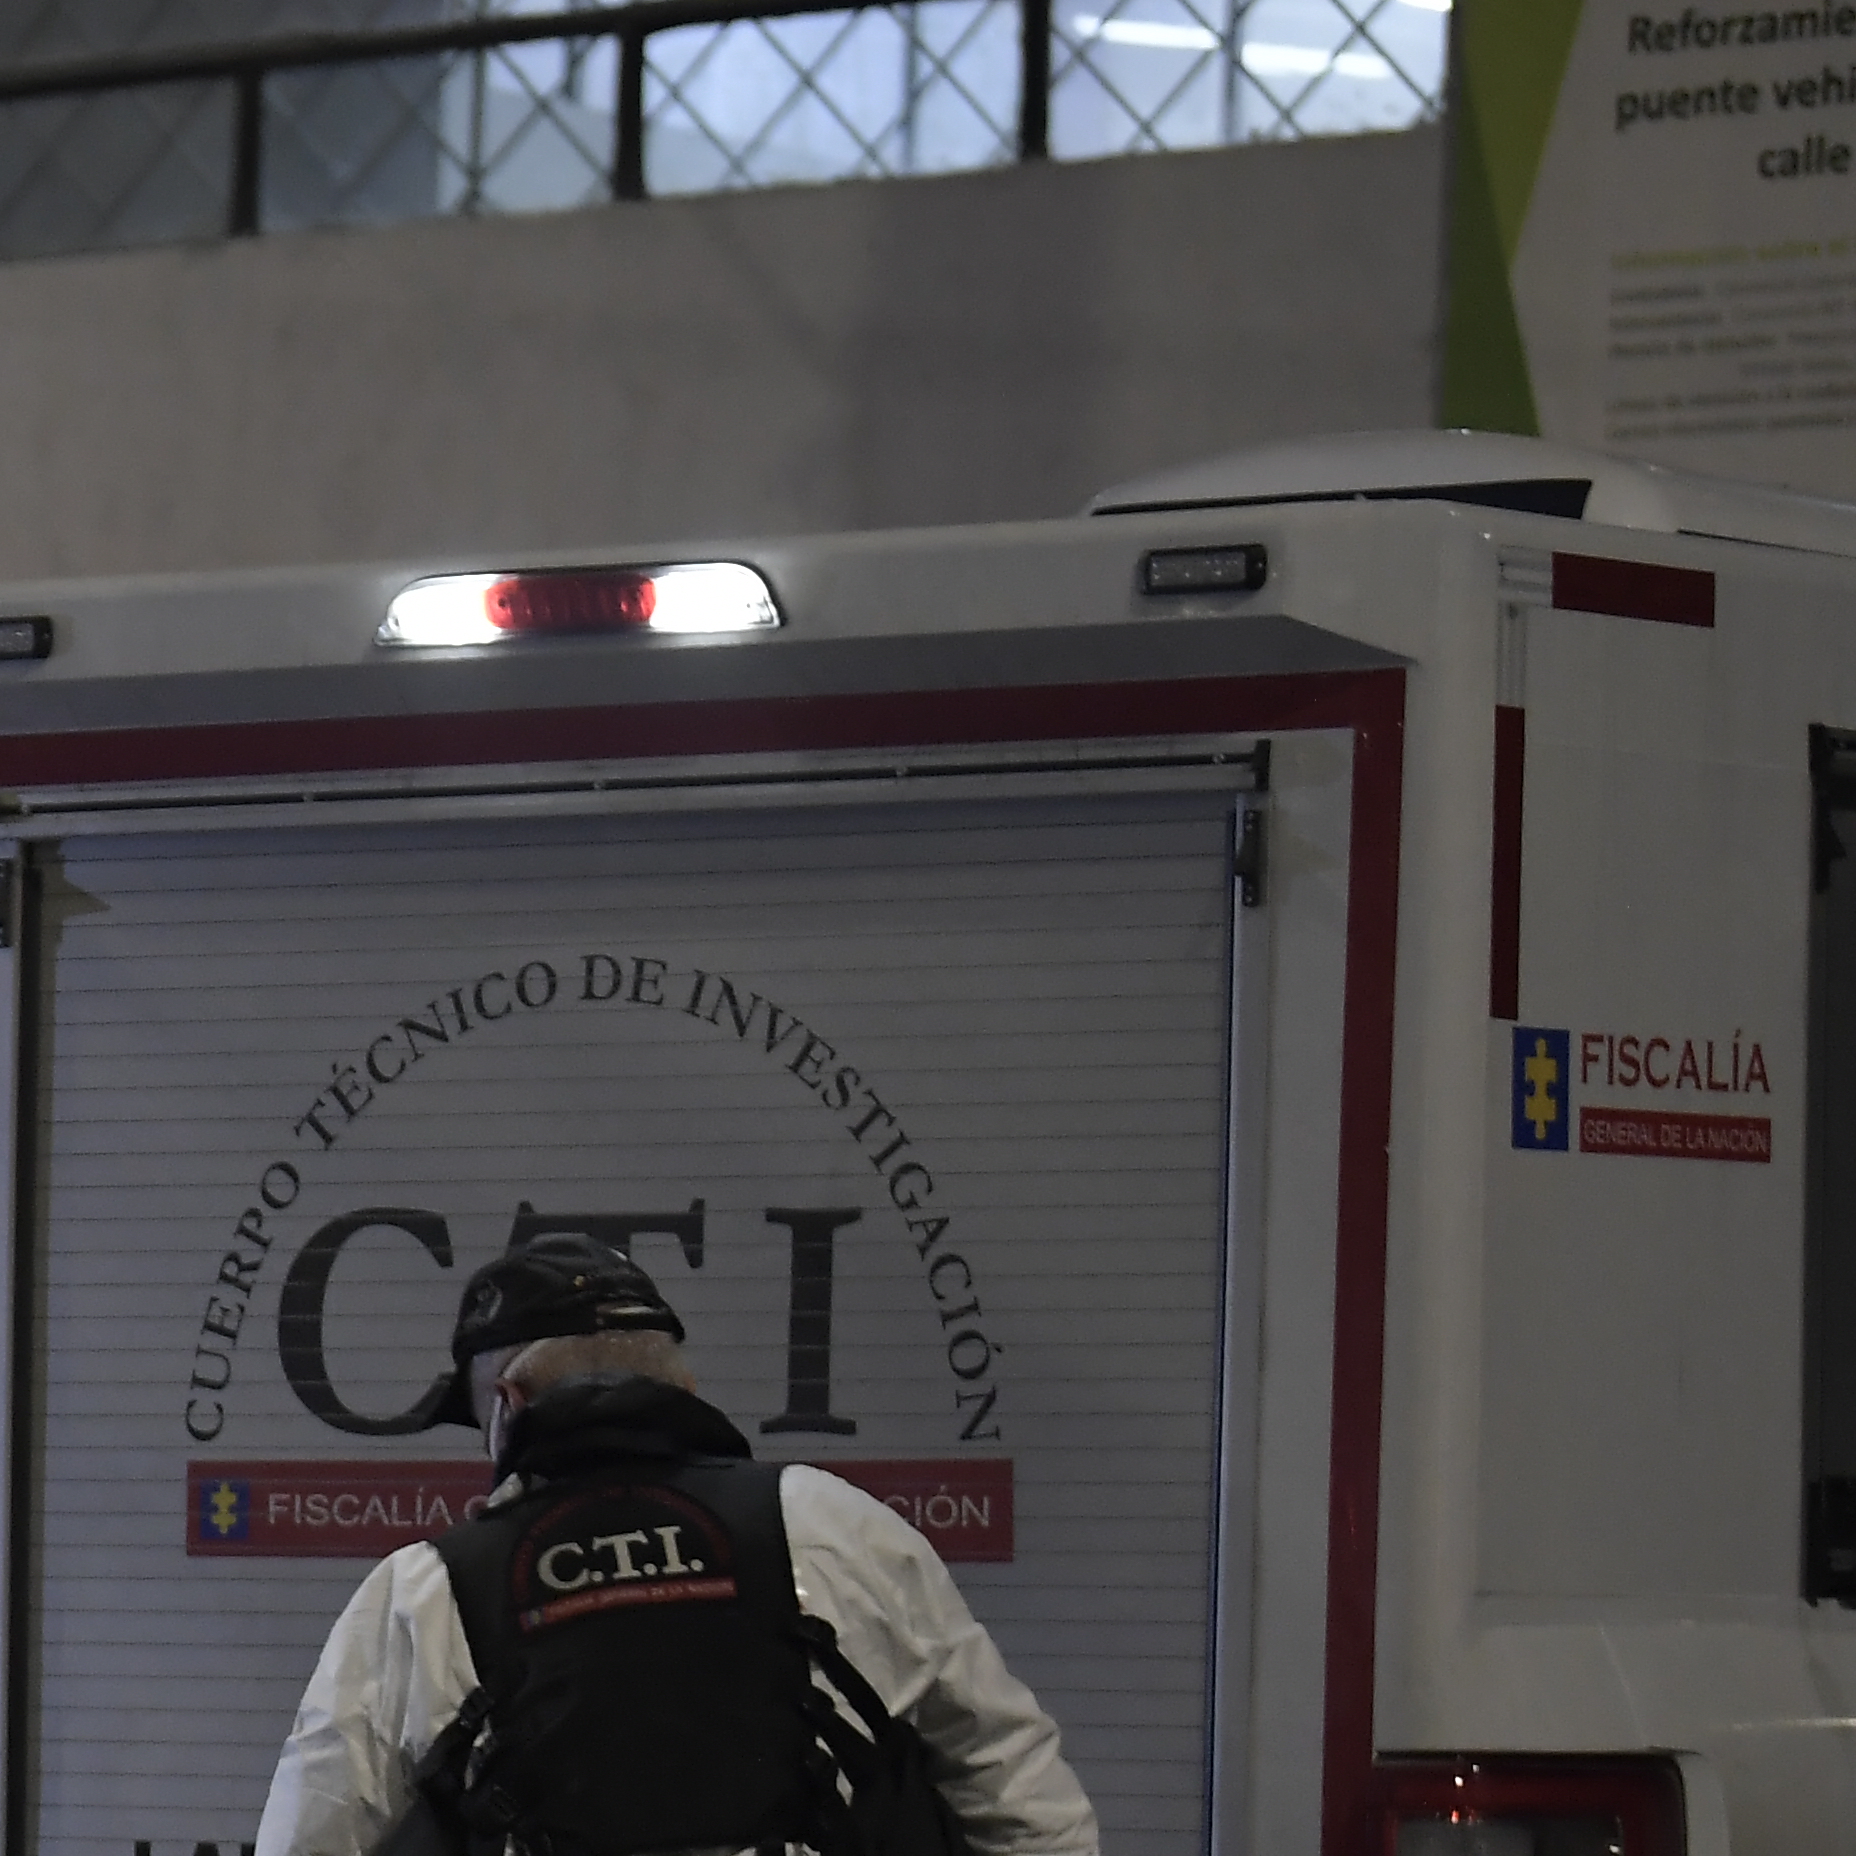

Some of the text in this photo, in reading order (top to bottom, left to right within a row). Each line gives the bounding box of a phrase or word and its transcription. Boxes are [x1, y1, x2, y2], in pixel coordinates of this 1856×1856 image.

[1614, 78, 1761, 132] puente
[1758, 133, 1852, 179] calle
[1581, 1028, 1771, 1092] FISCALÍA
[1584, 1119, 1657, 1146] GENERAL
[1660, 1124, 1683, 1149] DE
[1686, 1127, 1704, 1150] LA
[187, 953, 1004, 1442] CUERPO TÉCNICO DE INVESTIGACIÓN
[267, 1486, 454, 1528] FISCALÍA
[537, 1524, 706, 1590] C.T.I.
